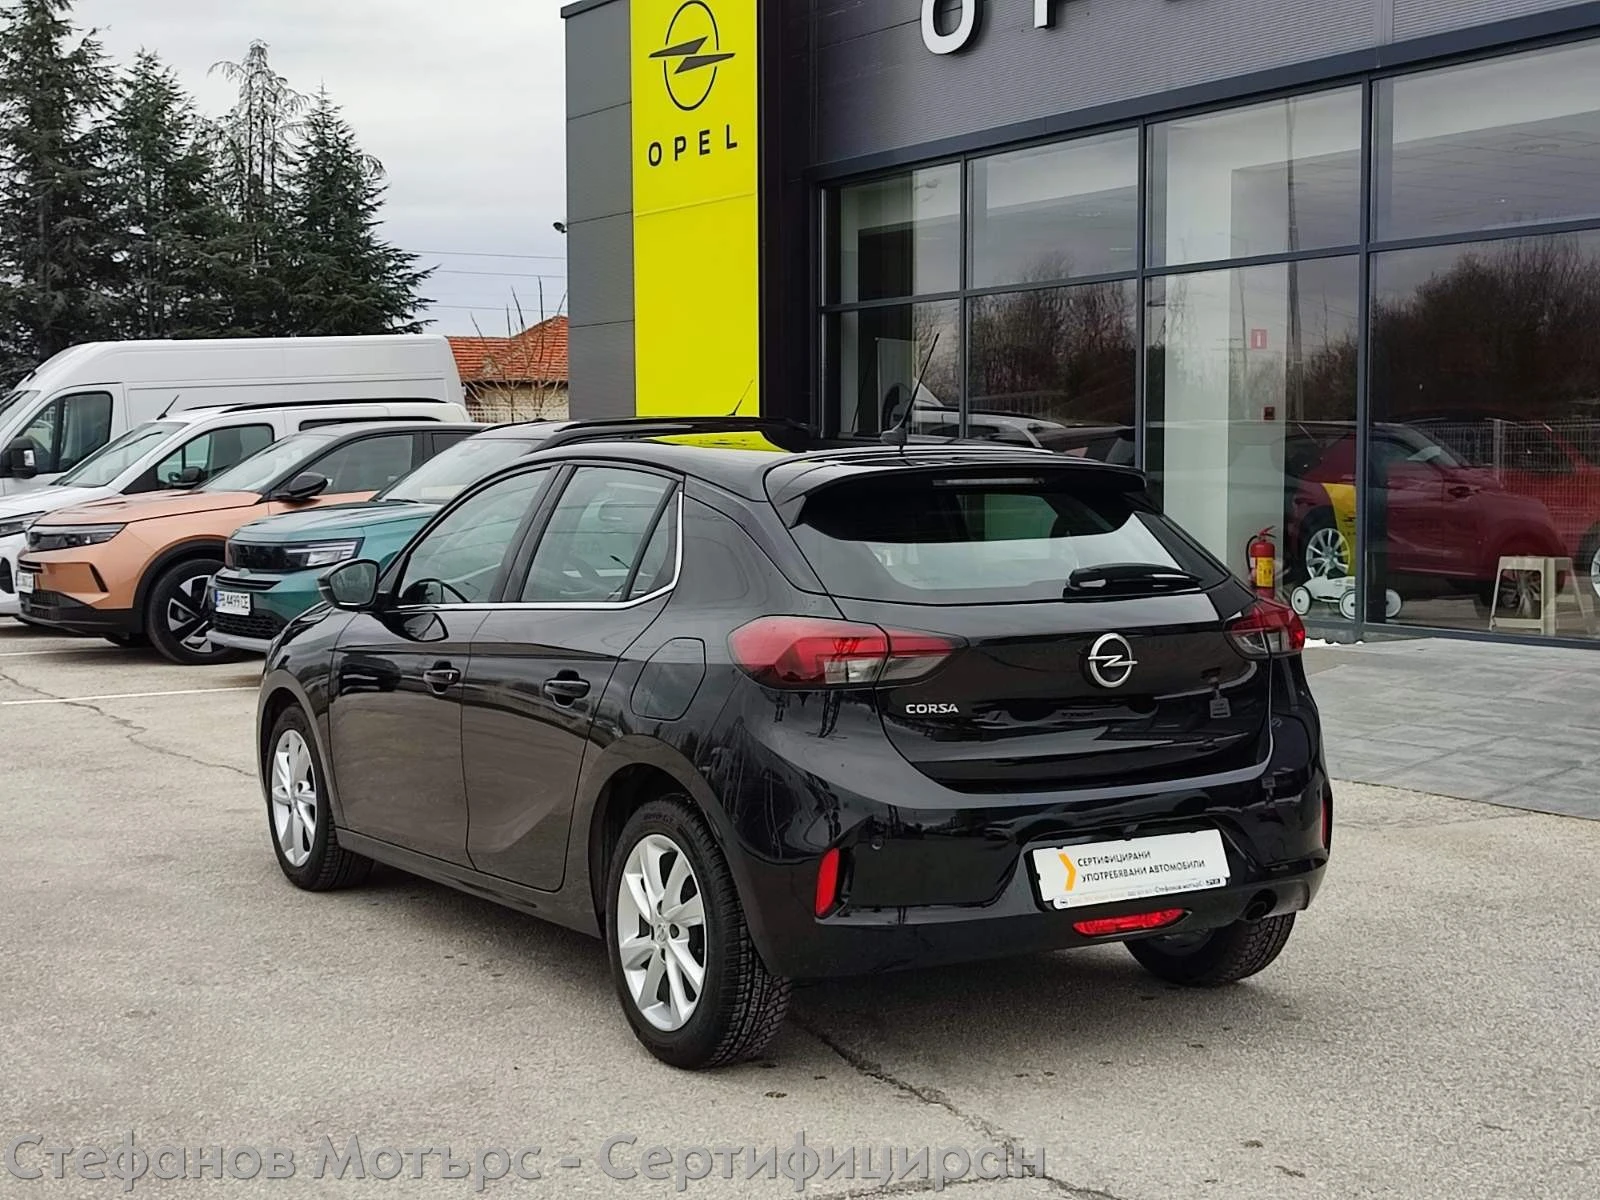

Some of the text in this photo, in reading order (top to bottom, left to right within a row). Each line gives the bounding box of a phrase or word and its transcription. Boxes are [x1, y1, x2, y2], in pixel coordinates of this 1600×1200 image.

[648, 124, 738, 167] OPEL
[905, 703, 960, 714] CORSA
[1077, 851, 1151, 867] СЕРТИФИЦИРАНИ
[1080, 860, 1206, 882] УПОТРЕБЯВАНИ АВТОМОБИЛИ
